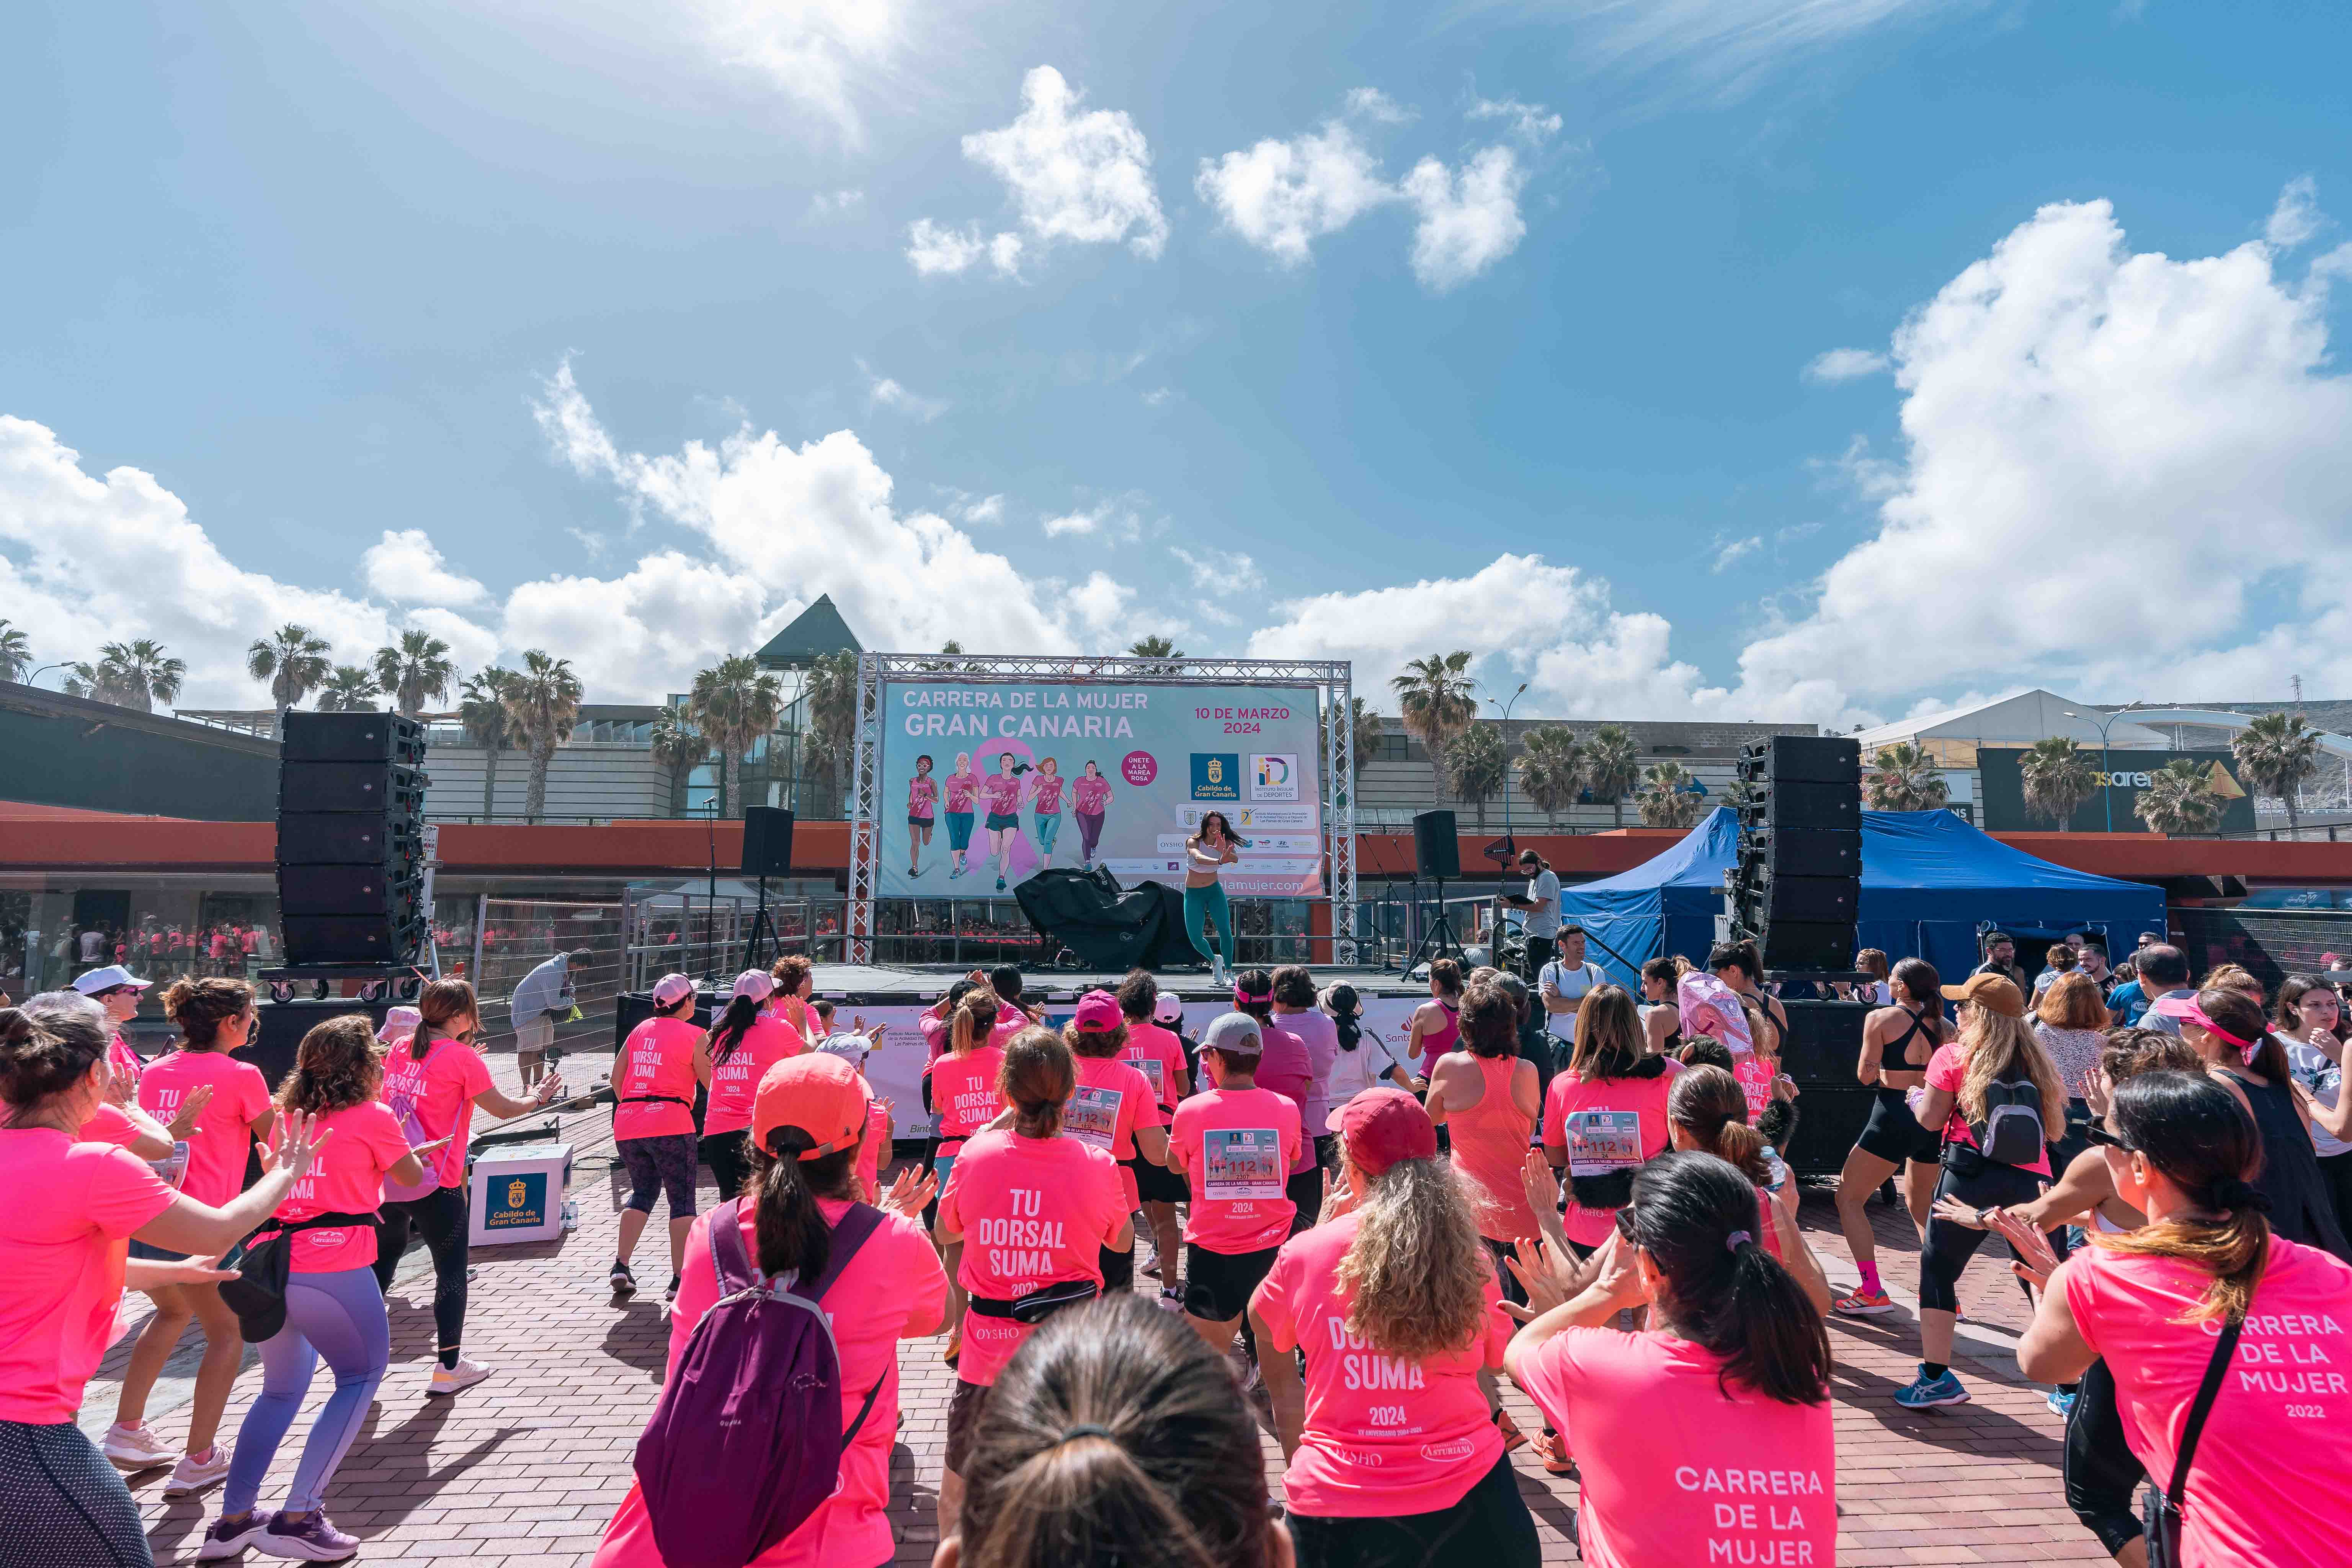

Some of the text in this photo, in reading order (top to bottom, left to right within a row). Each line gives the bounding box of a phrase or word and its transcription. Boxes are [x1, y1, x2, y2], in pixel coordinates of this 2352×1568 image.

[904, 691, 1148, 710] CARRERA DE LA MUJER
[1195, 707, 1289, 720] 10 DE MARZO
[905, 714, 1134, 738] GRAN CANARIA
[1223, 722, 1261, 734] 2024
[643, 1037, 656, 1050] TU
[633, 1051, 663, 1066] DORSAL
[1129, 1047, 1144, 1060] TU
[402, 1062, 421, 1077] TU
[717, 1066, 749, 1080] SUMA
[966, 1076, 983, 1091] TU
[159, 1089, 180, 1107] TU
[954, 1091, 999, 1110] DORSAL
[959, 1107, 993, 1124] SUMA
[1077, 1112, 1097, 1124] 112
[910, 1125, 929, 1133] Bint
[1590, 1141, 1616, 1152] 112
[1229, 1160, 1256, 1173] 112
[1010, 1188, 1041, 1217] TU
[1232, 1202, 1254, 1213] 2024
[493, 1210, 524, 1218] Cabildo
[510, 1216, 541, 1224] Canaria
[312, 1236, 343, 1244] ASTURIANA
[980, 1218, 1066, 1248] DORSAL
[989, 1249, 1054, 1277] SUMA
[977, 1327, 1019, 1340] OYSHO
[2240, 1344, 2331, 1364] DE LA
[1343, 1355, 1425, 1390] SUMA
[2239, 1371, 2349, 1395] MUJER
[1369, 1405, 1407, 1426] 2024
[2285, 1404, 2326, 1419] 2022
[1425, 1445, 1471, 1456] ASTURIANA
[1676, 1466, 1824, 1495] CARRERA
[1715, 1504, 1805, 1531] DE LA
[1708, 1538, 1813, 1566] MUJER
